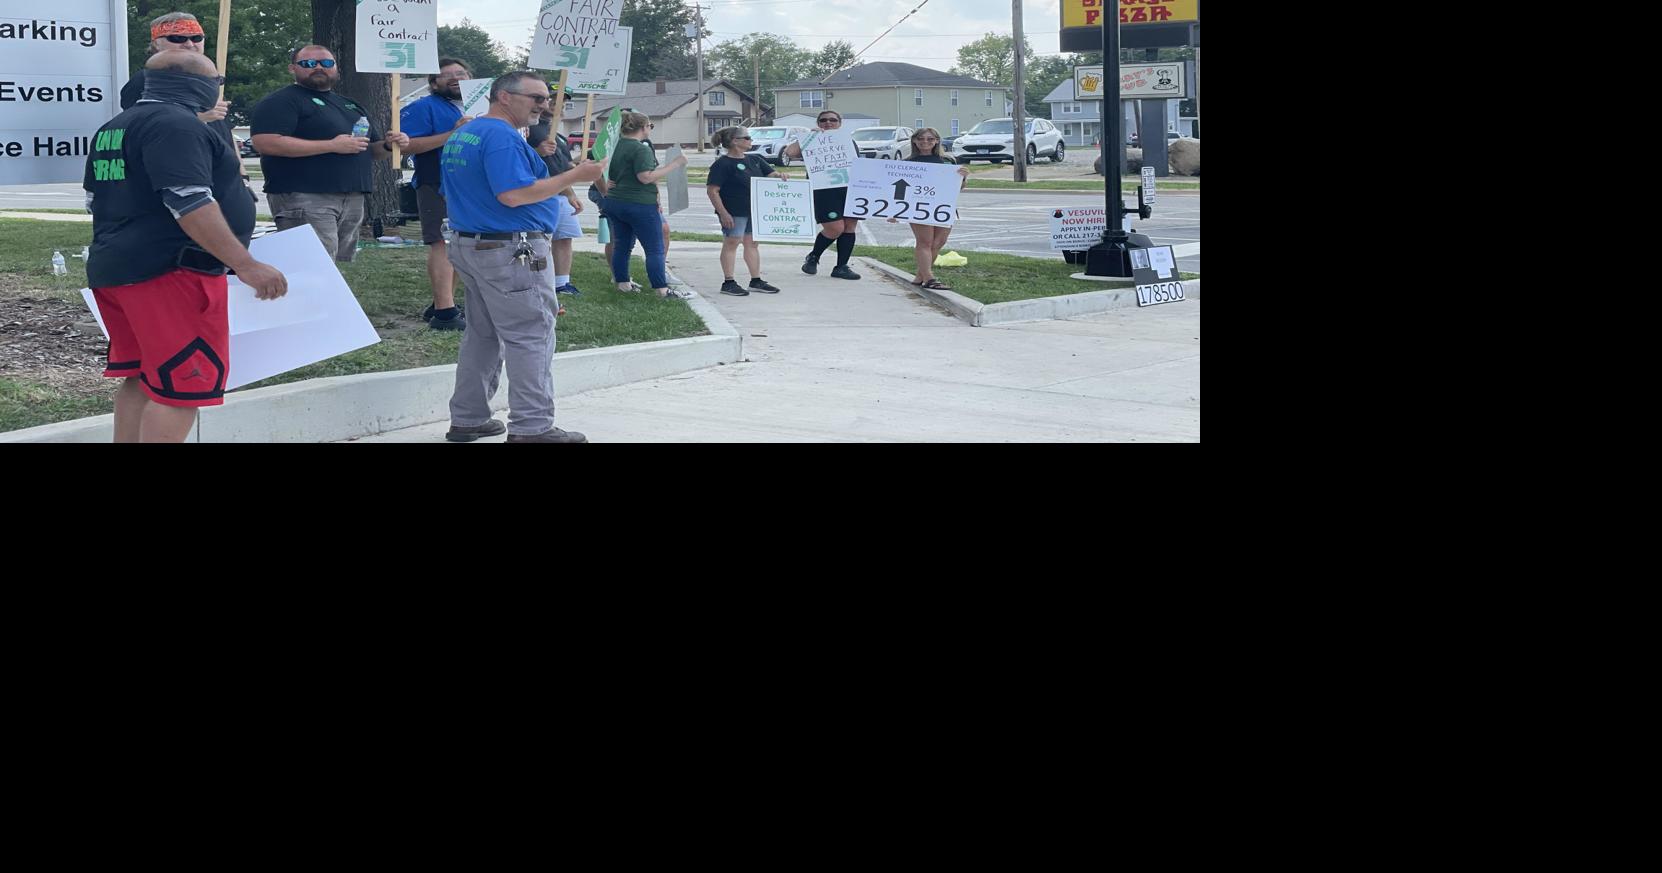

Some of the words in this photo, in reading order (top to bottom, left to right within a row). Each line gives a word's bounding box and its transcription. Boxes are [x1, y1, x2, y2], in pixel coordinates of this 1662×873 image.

[569, 0, 614, 17] FAIR
[1085, 6, 1173, 24] PZZA
[378, 28, 432, 40] Contract
[383, 42, 416, 68] 31
[555, 45, 591, 69] 31
[0, 81, 104, 102] Events
[33, 136, 89, 157] Hall
[817, 135, 834, 146] WE
[897, 164, 929, 172] CLERICAL
[887, 171, 924, 179] TECHNICAL
[777, 182, 789, 190] We
[913, 185, 936, 197] 3%
[764, 190, 803, 199] Deserve
[773, 206, 796, 214] FAIR
[852, 197, 952, 223] 32256
[762, 214, 807, 223] CONTRACT
[1064, 232, 1081, 240] CALL
[1138, 281, 1184, 304] 178500
